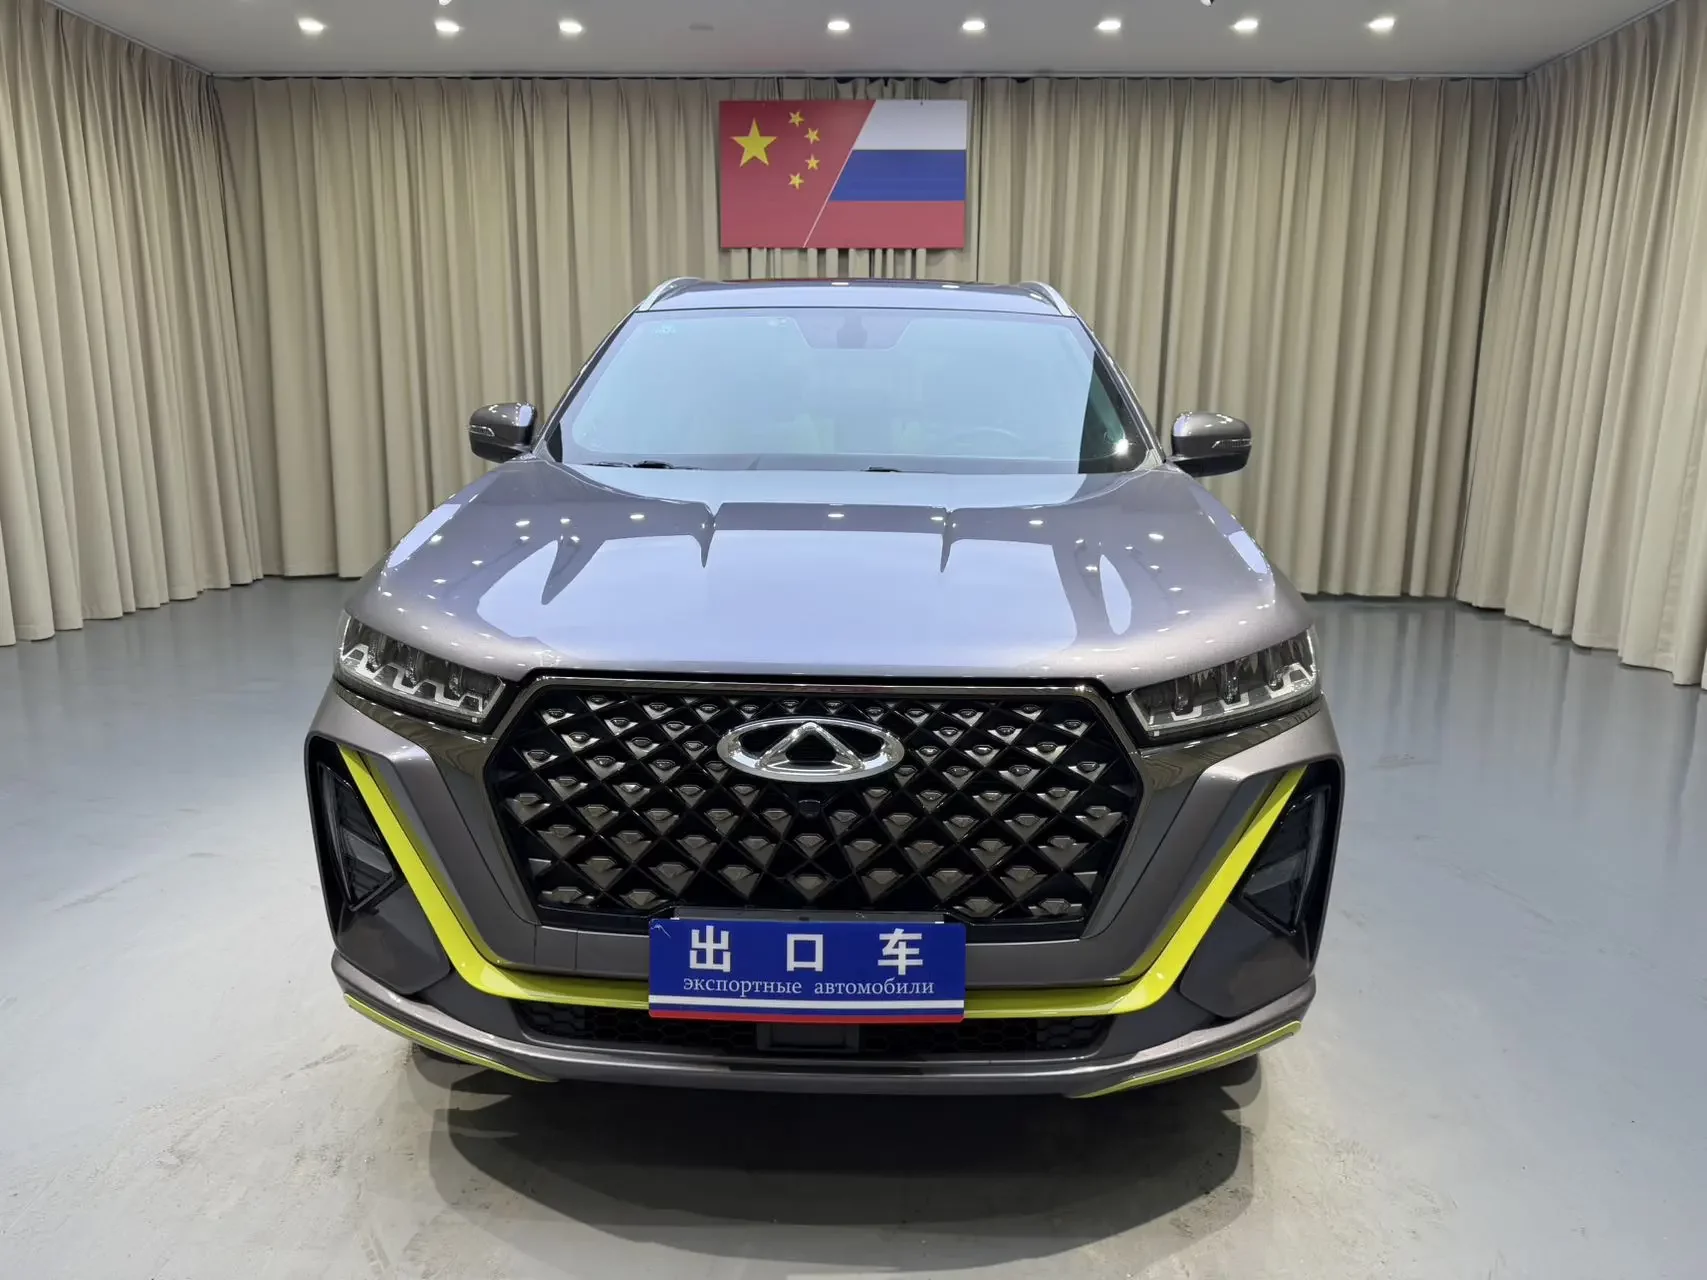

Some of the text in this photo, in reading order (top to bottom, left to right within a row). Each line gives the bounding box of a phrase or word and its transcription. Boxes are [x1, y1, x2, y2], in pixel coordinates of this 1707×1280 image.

[689, 925, 923, 976] 出口车
[683, 977, 935, 997] экспортные автомобили
